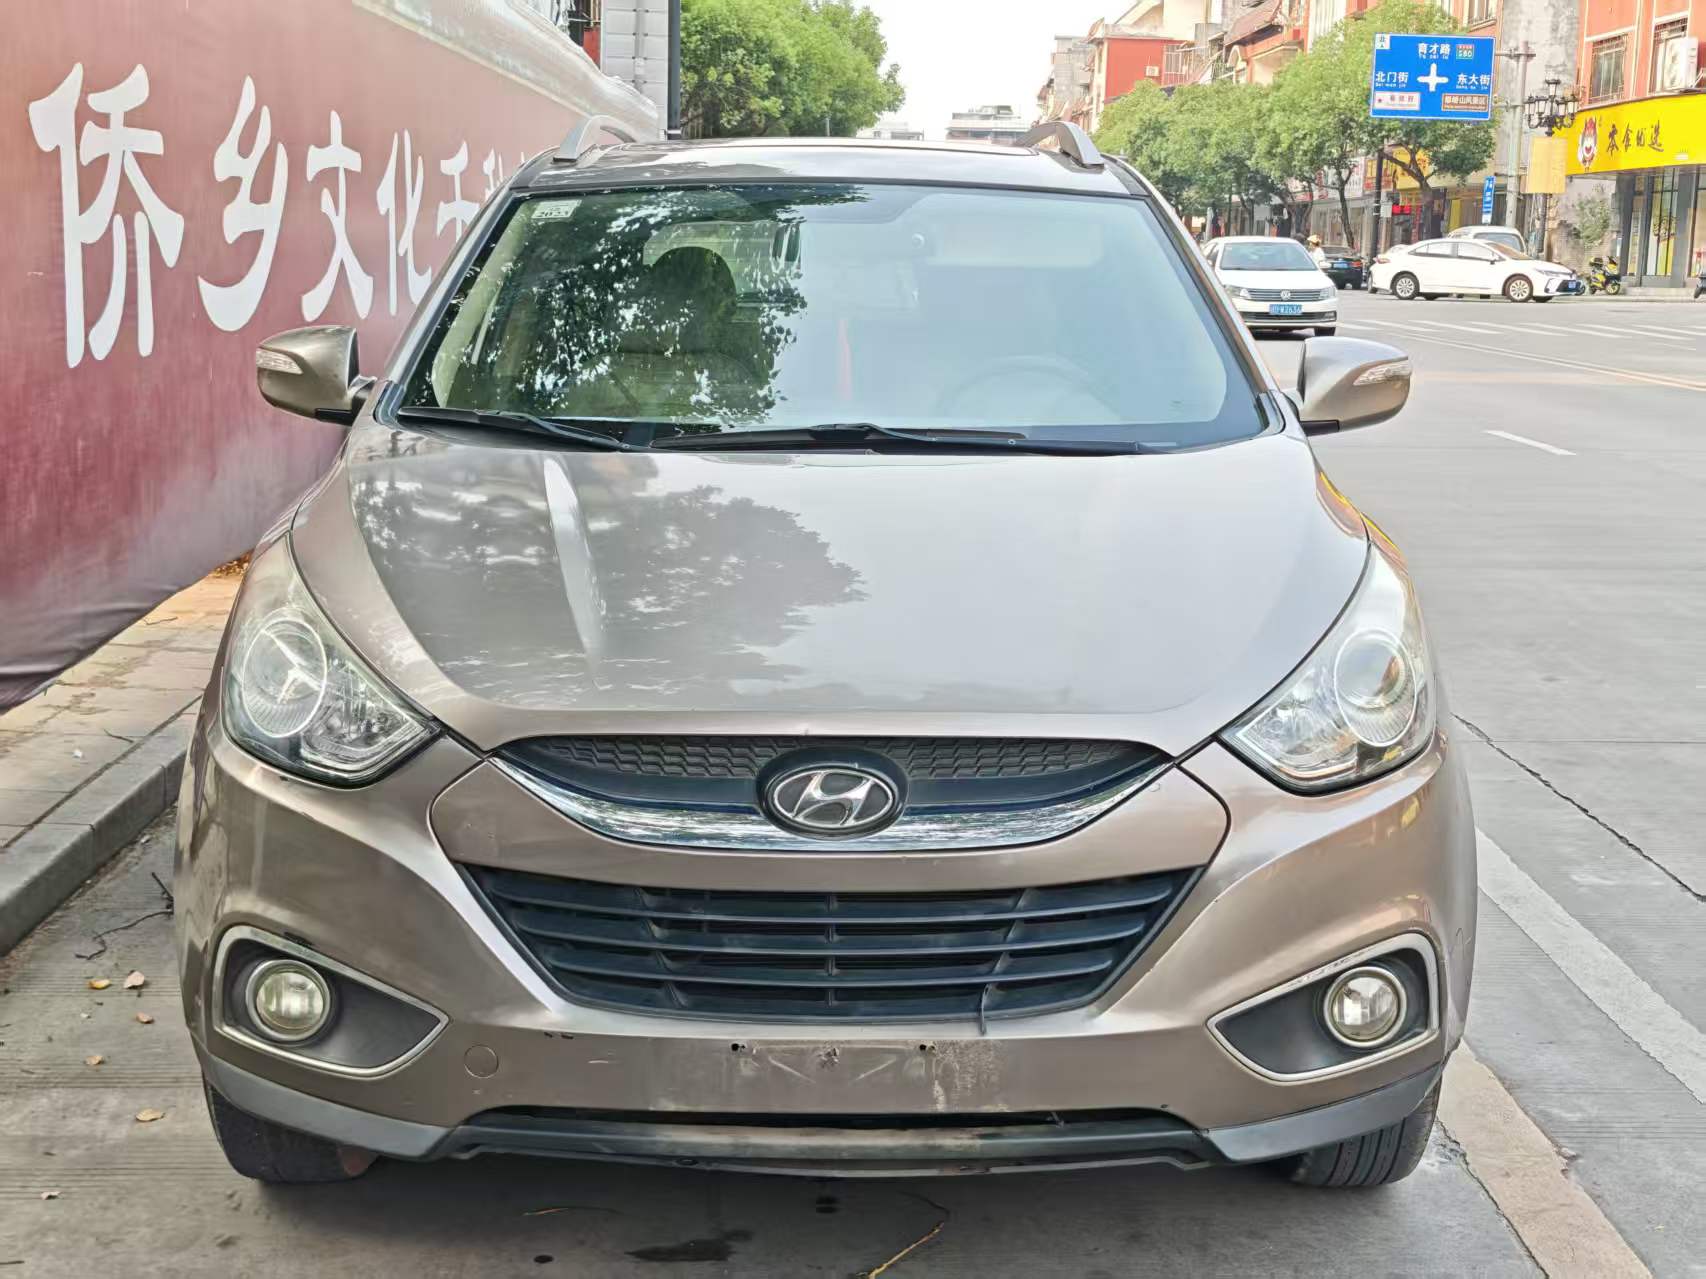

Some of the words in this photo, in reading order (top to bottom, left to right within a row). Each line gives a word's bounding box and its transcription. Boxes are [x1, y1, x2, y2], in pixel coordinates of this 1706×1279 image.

[1418, 43, 1451, 55] 育才路
[1375, 71, 1409, 83] 北门街
[1457, 73, 1491, 86] 东大街
[28, 62, 525, 368] 侨乡文化千
